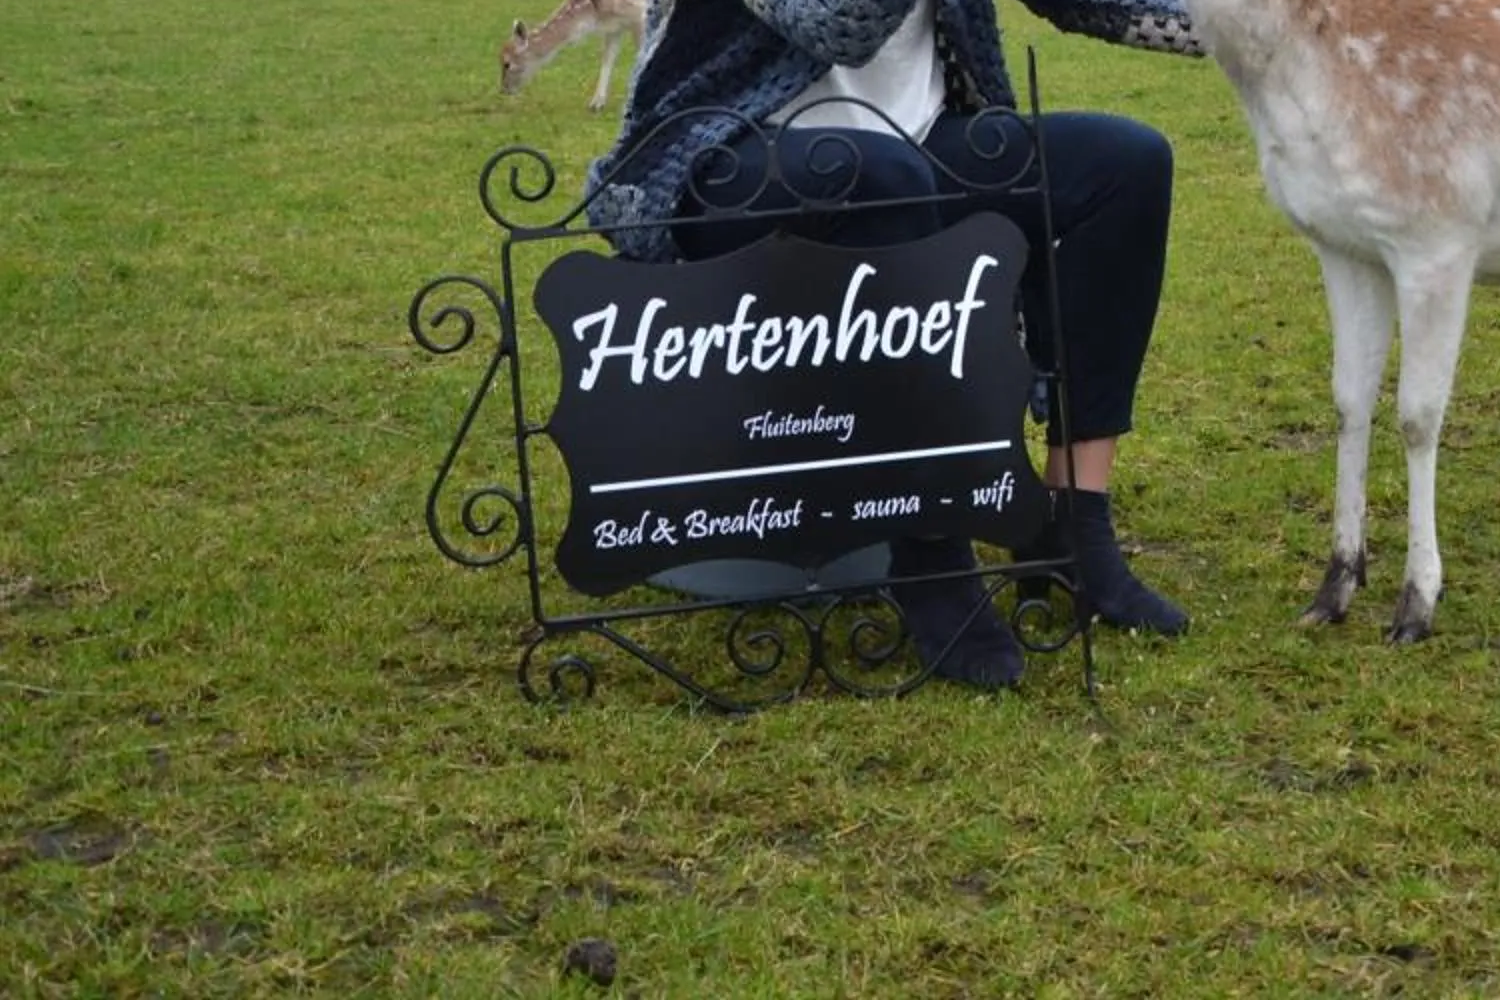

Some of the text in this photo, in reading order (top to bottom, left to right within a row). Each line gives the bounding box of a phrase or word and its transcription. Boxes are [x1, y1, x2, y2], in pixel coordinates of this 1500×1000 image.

[572, 254, 999, 392] Hertenhoef
[743, 405, 855, 443] Fluitenberg
[593, 510, 651, 549] Bed
[650, 517, 678, 546] &
[684, 498, 803, 539] Breakfast
[851, 495, 920, 520] sauna
[972, 472, 1014, 512] wifi
